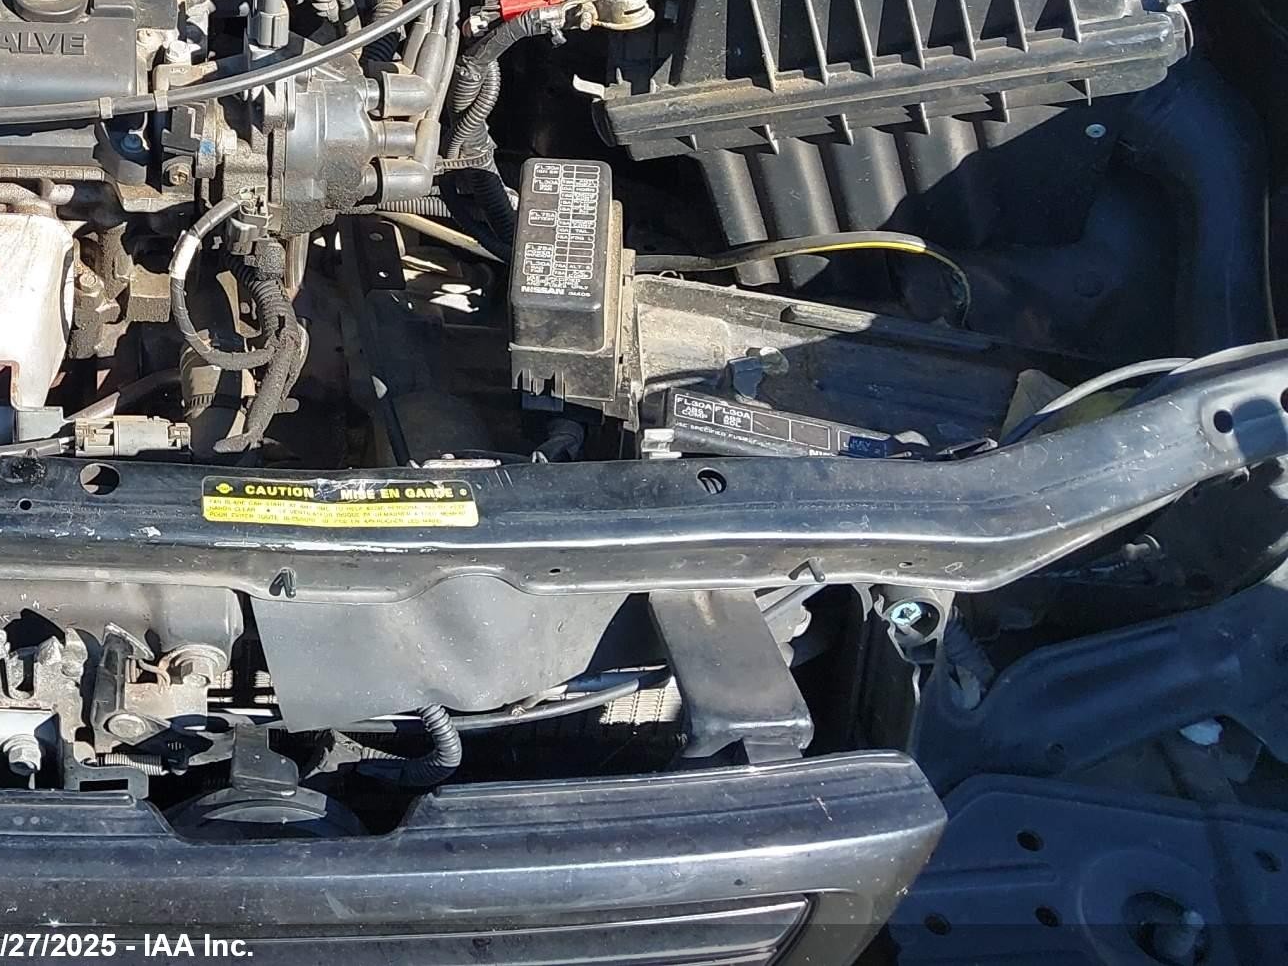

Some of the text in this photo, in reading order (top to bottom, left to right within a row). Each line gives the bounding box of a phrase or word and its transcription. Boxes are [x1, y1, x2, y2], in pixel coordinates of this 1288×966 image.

[520, 285, 565, 295] NISSAN
[244, 484, 315, 499] CAUTION
[380, 488, 400, 499] EN
[404, 488, 454, 499] GARDE
